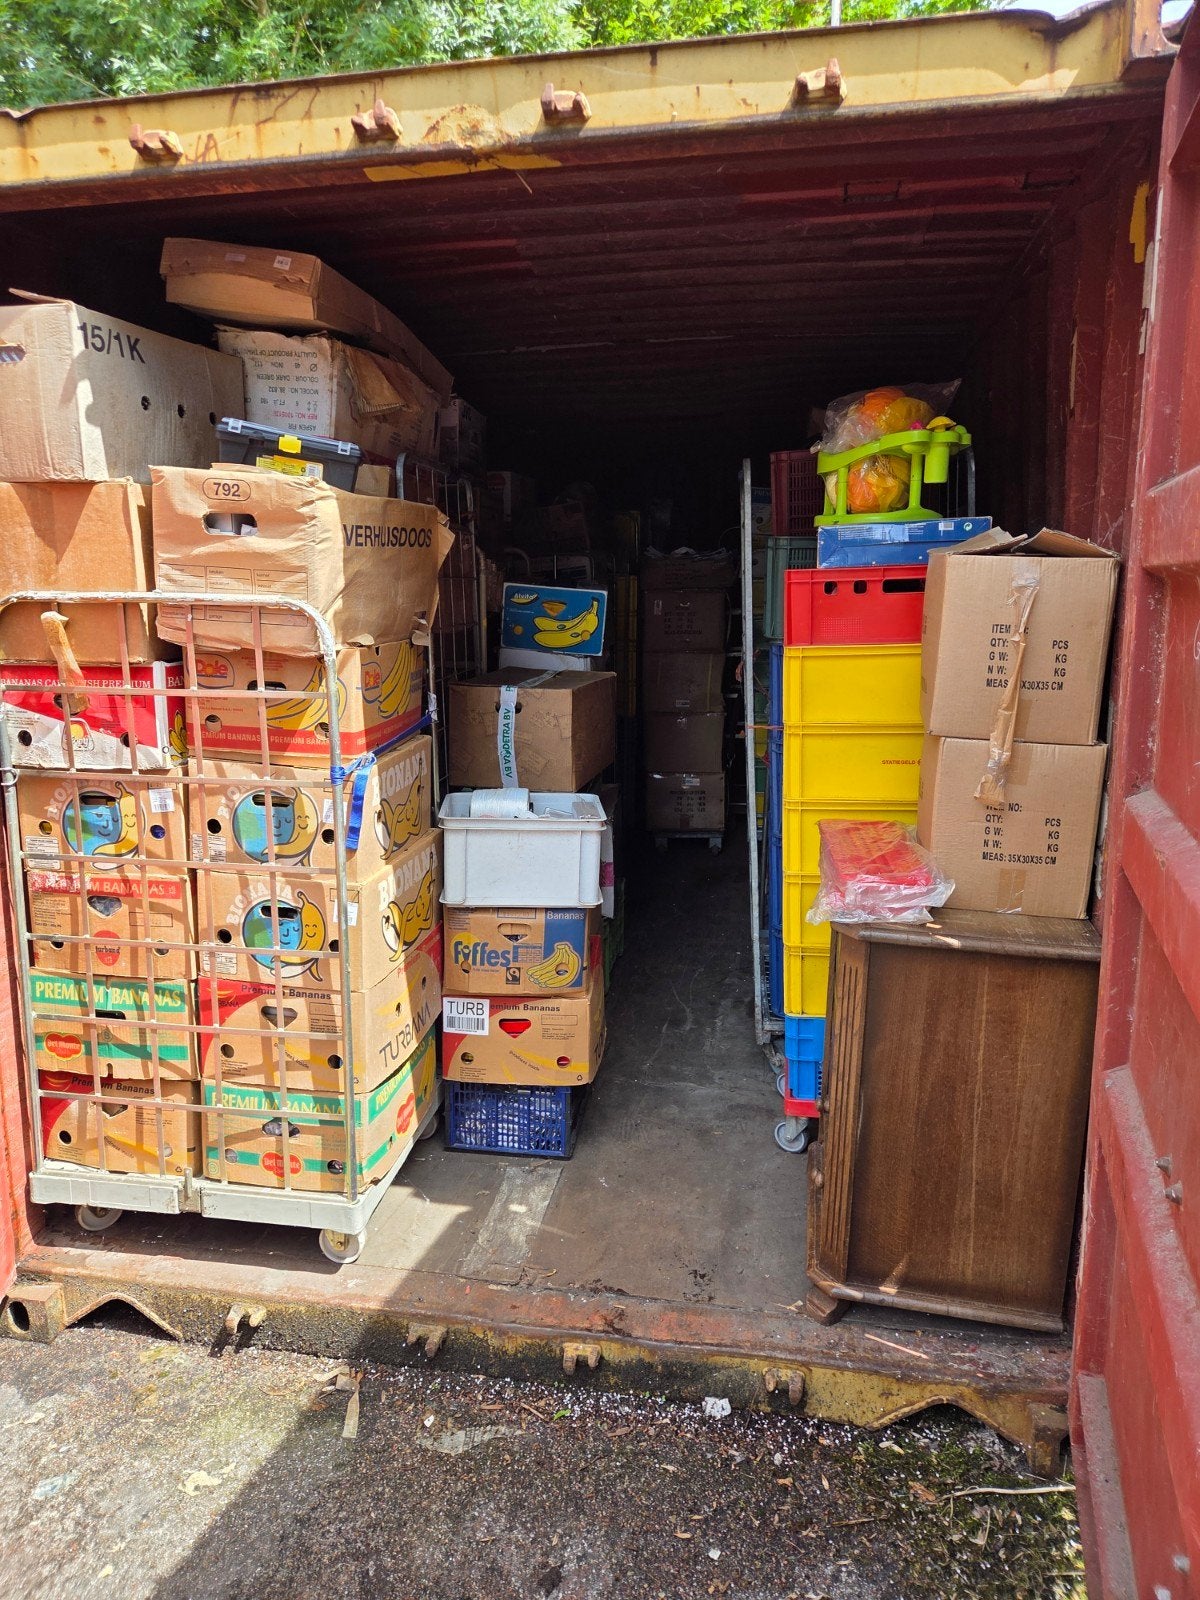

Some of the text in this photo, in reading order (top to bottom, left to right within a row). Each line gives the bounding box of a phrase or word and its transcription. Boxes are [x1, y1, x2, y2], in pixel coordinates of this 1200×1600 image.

[300, 387, 319, 395] MODEL
[213, 482, 241, 497] 792
[343, 524, 432, 548] VERHUISDOOS
[992, 624, 1011, 634] ITEM
[990, 638, 1069, 650] QTY: PCS
[989, 652, 1067, 664] G W: KG
[196, 660, 228, 674] Dole
[988, 665, 1066, 677] N W: KG
[364, 668, 380, 688] Dole
[102, 680, 151, 689] PREIUM
[1020, 681, 1049, 690] X30X35
[1051, 682, 1064, 690] CM
[503, 708, 510, 720] BV
[227, 733, 261, 742] BANANAS
[270, 736, 304, 745] PREMIUM
[504, 767, 512, 778] BV
[1008, 802, 1023, 812] NO:
[985, 814, 1061, 827] QTY: PCS
[984, 827, 1060, 840] G W: KG
[984, 839, 1059, 853] N W: KG
[982, 852, 1056, 865] MEAS: 35X30X35 CM
[547, 910, 585, 920] Bananas
[112, 988, 181, 1007] BANANAS
[241, 984, 332, 1000] Premiu Bananas
[446, 1001, 485, 1016] TURB
[379, 1002, 431, 1068] TURBANA
[71, 1077, 155, 1095] Premum Bananas
